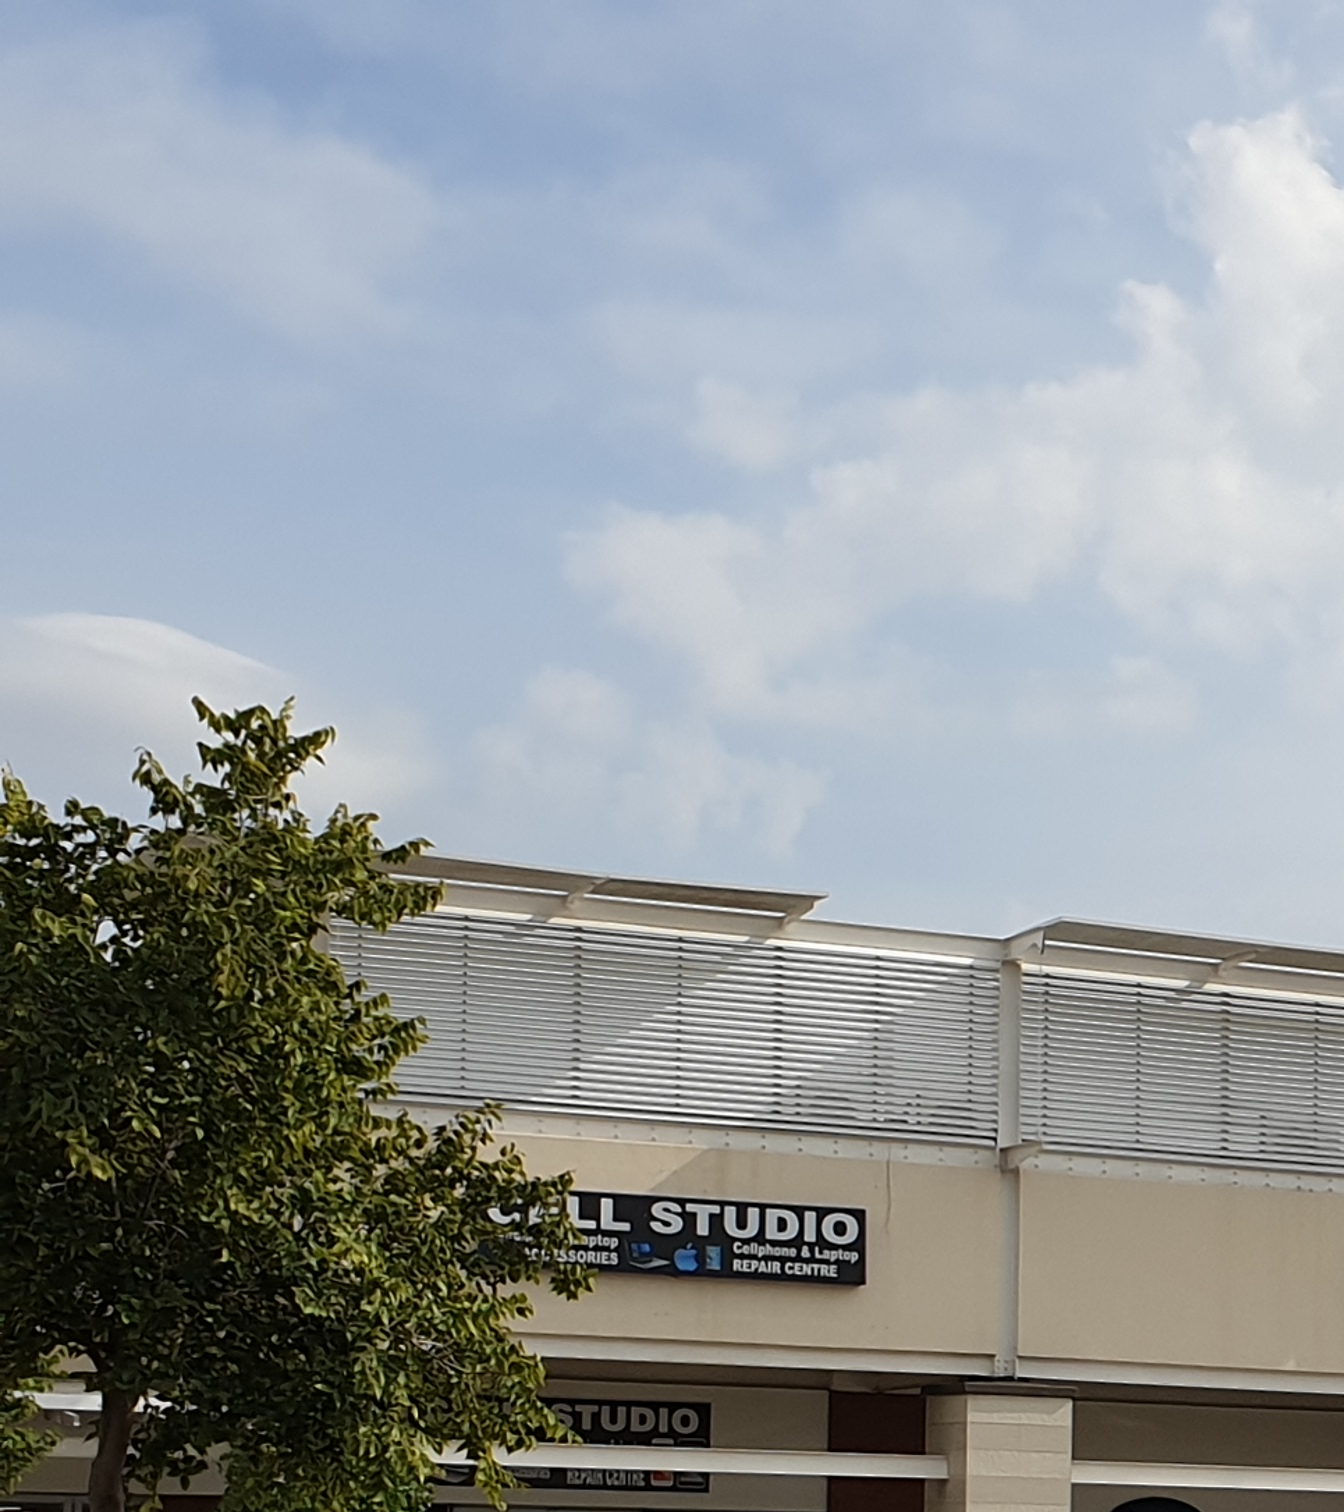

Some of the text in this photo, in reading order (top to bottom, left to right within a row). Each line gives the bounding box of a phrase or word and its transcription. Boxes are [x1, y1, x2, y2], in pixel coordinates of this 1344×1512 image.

[649, 1201, 859, 1245] STUDIO
[733, 1241, 859, 1264] Cellphone & Laptop
[733, 1259, 838, 1277] REPAIR CENTRE
[551, 1403, 699, 1434] STUDIO
